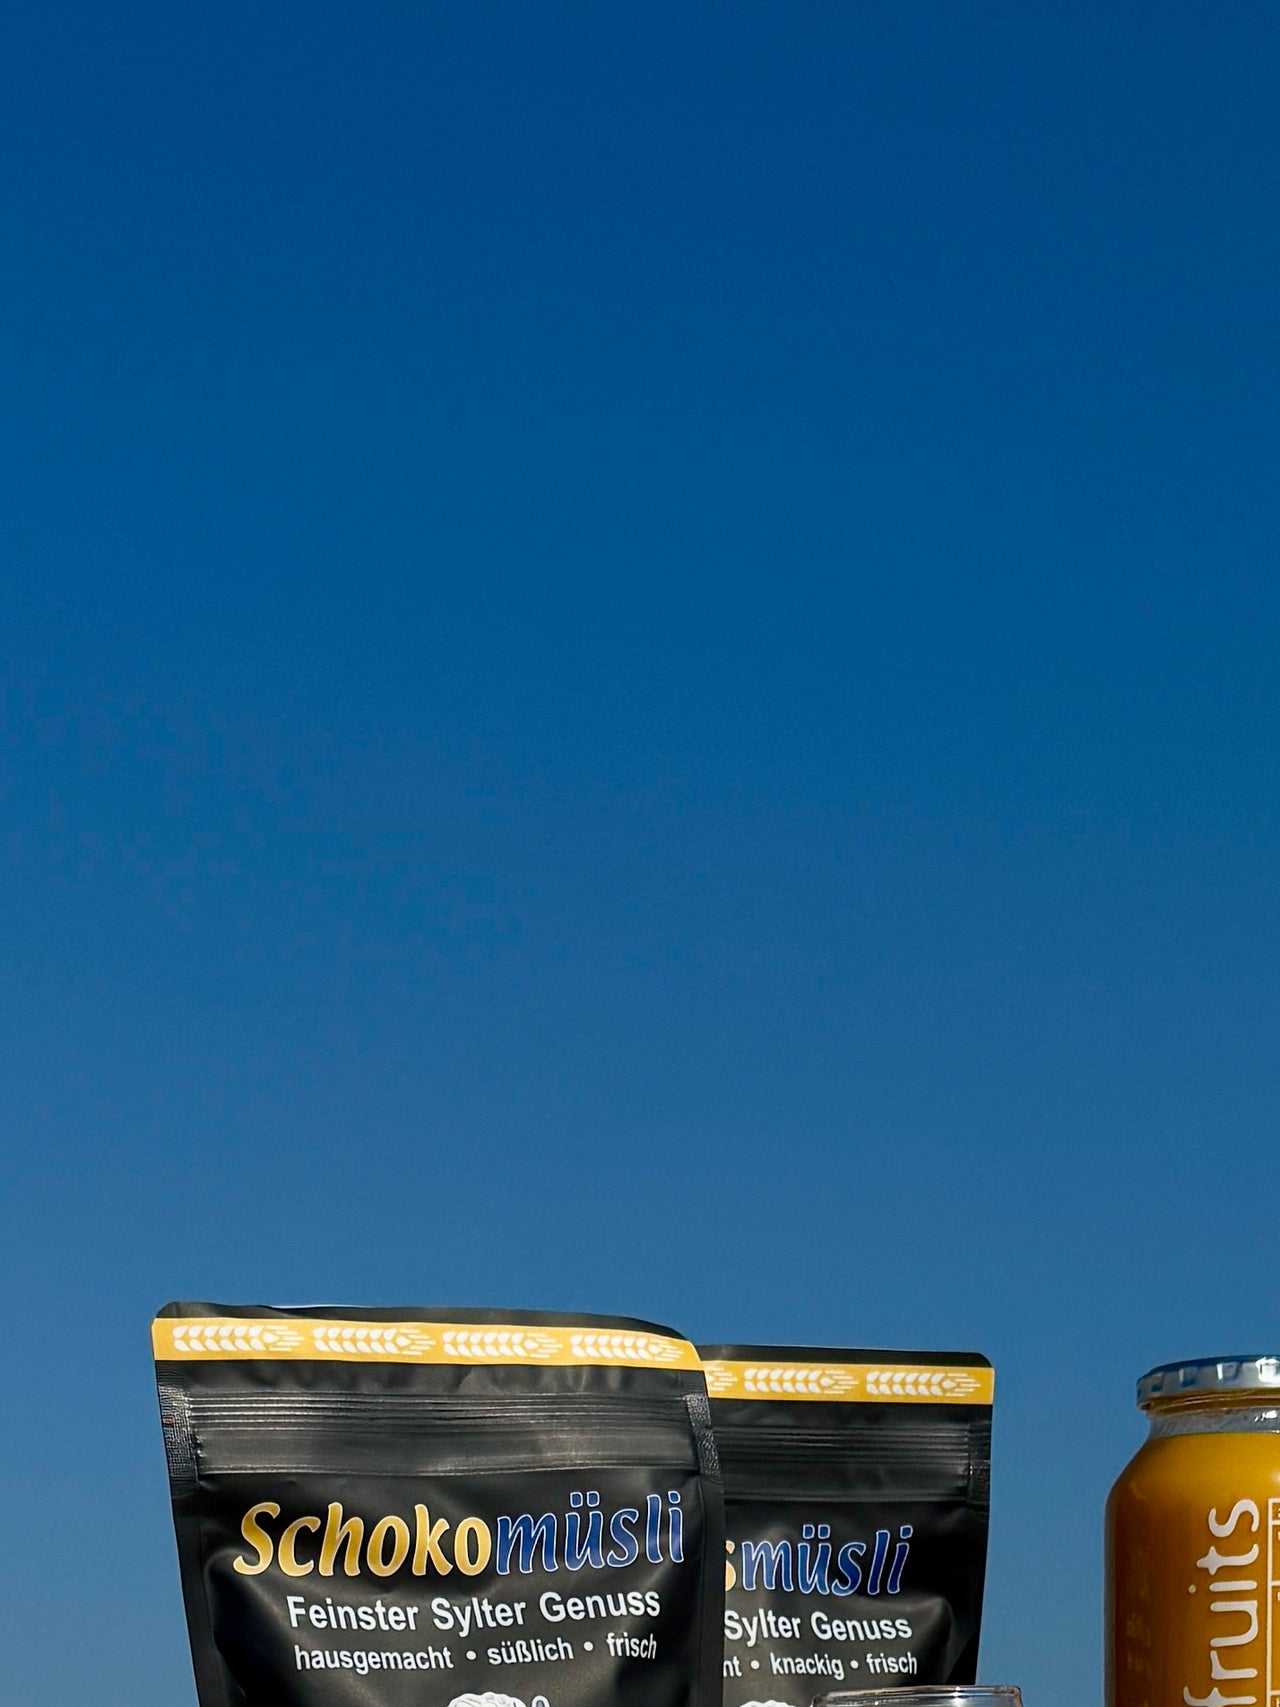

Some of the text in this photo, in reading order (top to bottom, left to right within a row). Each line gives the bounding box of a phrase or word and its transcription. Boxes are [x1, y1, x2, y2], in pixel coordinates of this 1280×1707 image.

[232, 1490, 685, 1578] Schokomüsli
[286, 1588, 662, 1638] Feinster Sylter Genuss
[724, 1608, 913, 1648] Sylter Genuss
[294, 1631, 658, 1676] hausgemacht süßlich frisch
[770, 1651, 845, 1681] knackig
[866, 1650, 918, 1675] frisch
